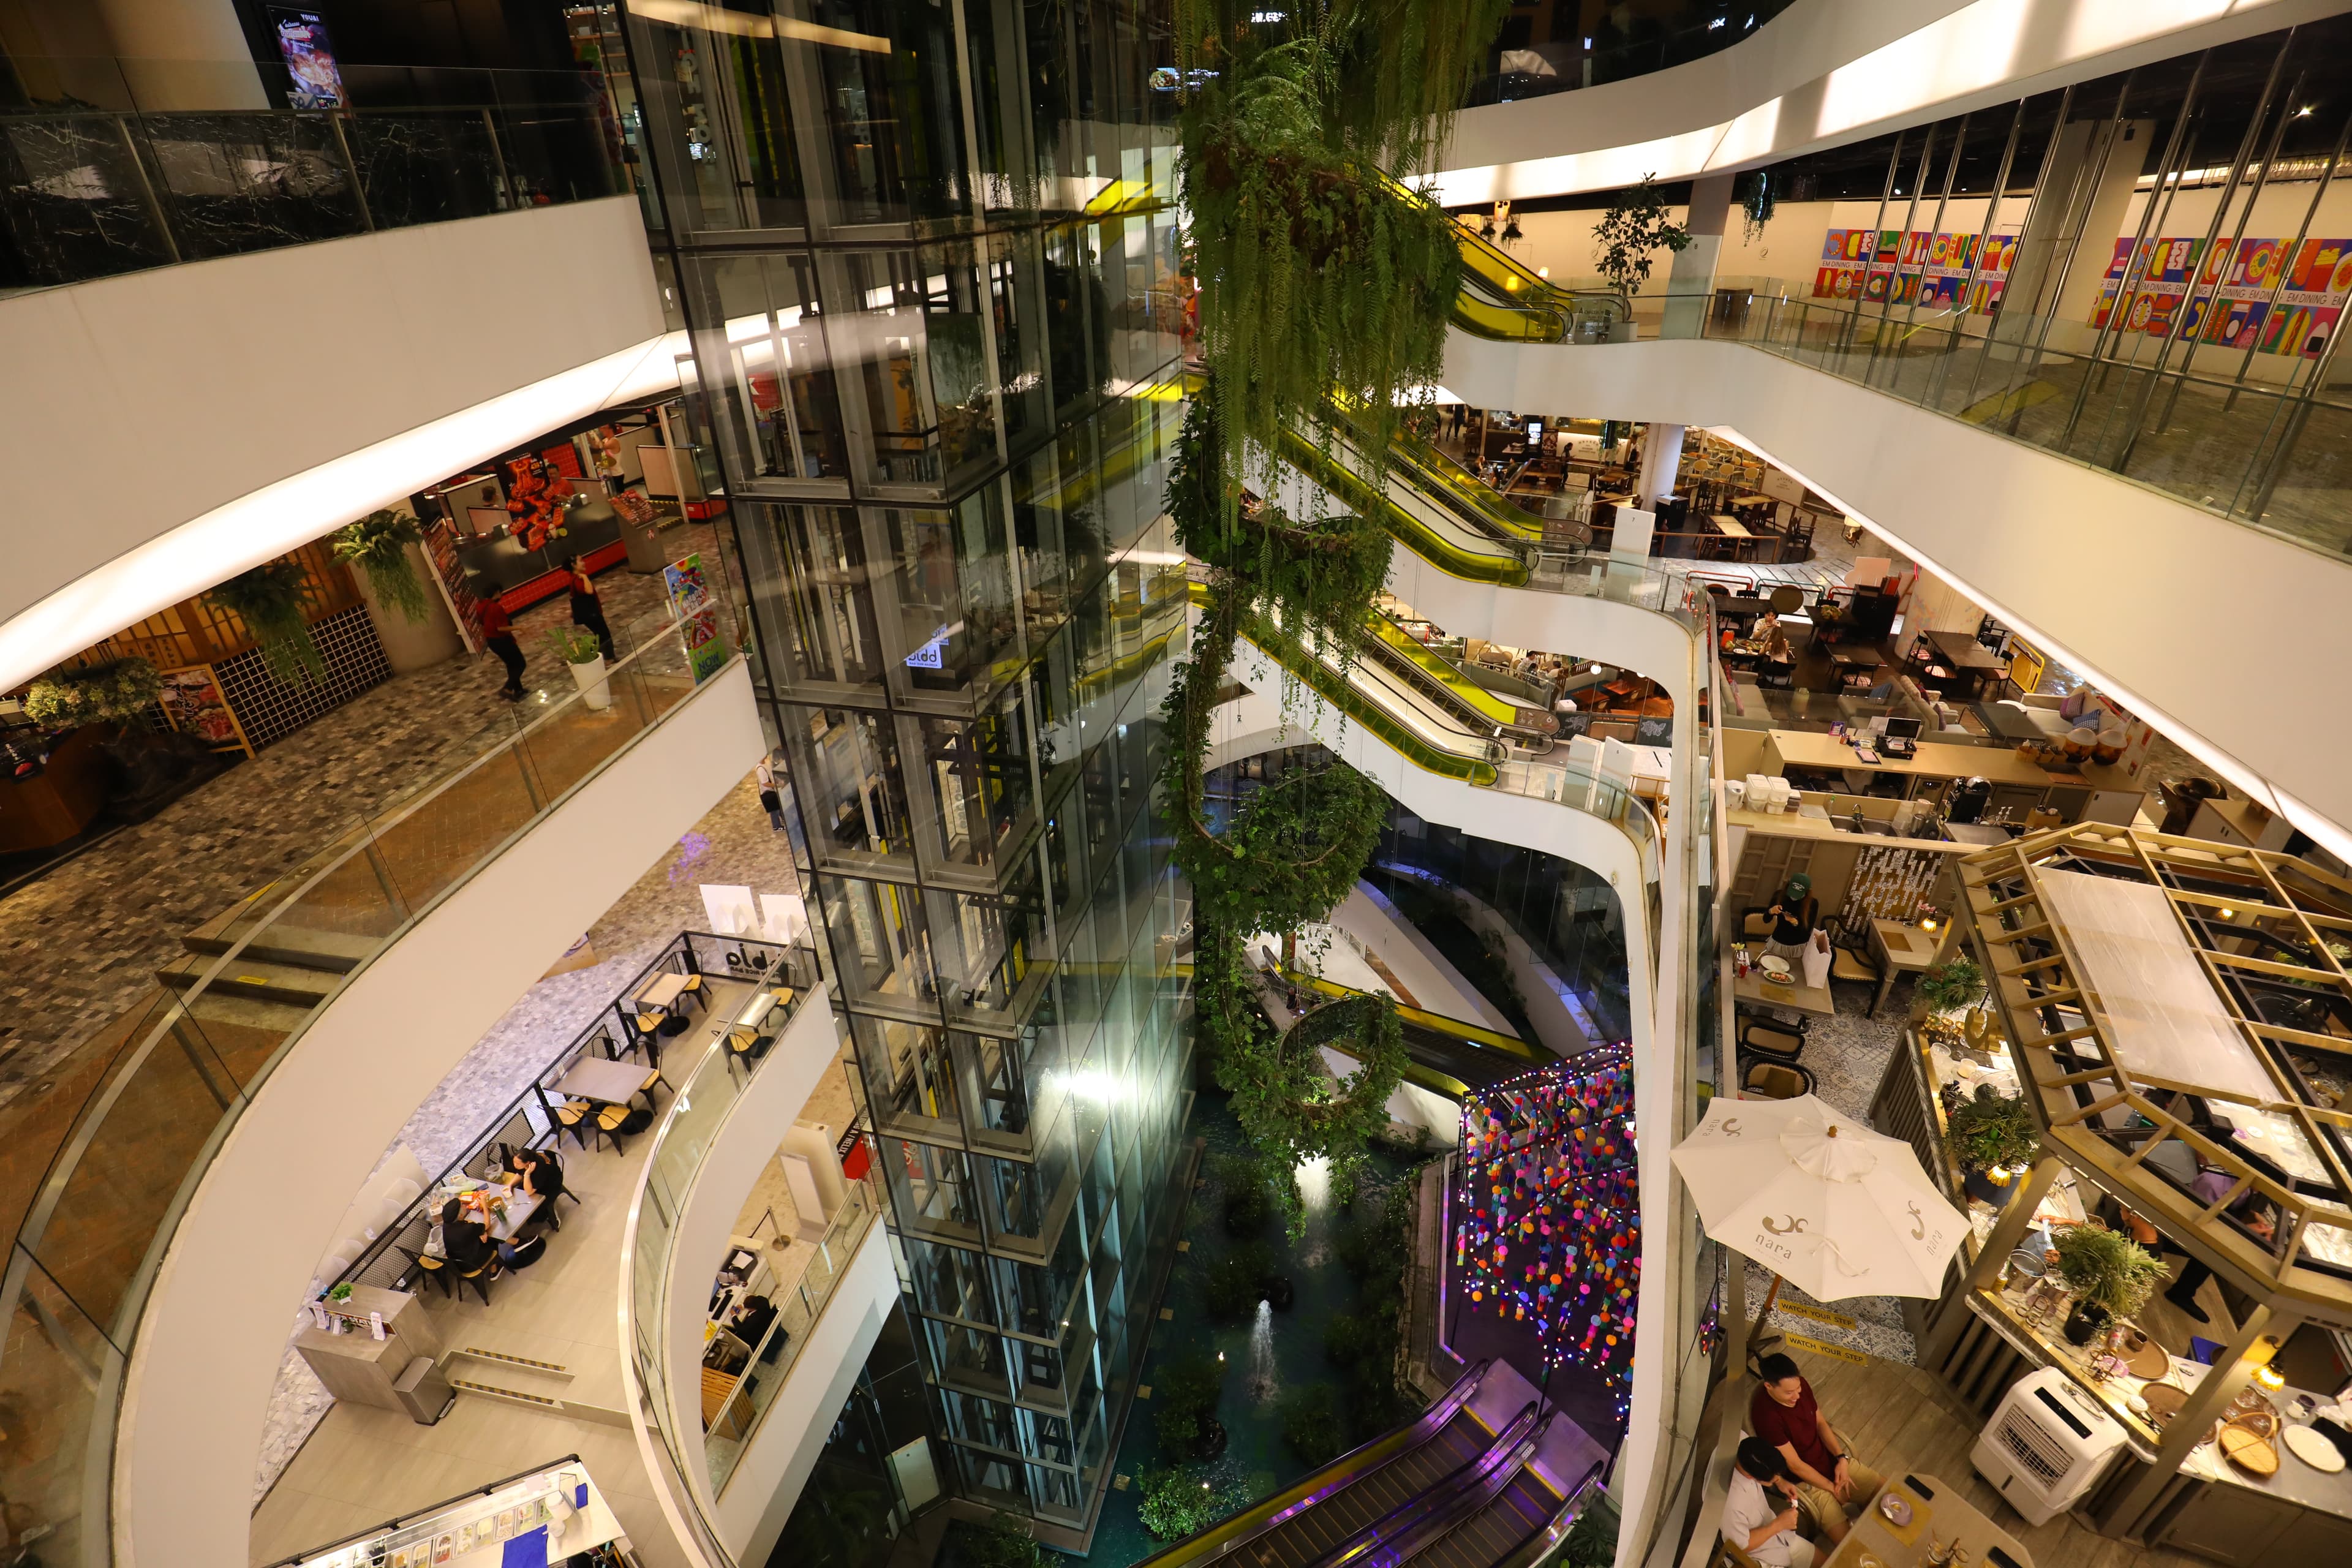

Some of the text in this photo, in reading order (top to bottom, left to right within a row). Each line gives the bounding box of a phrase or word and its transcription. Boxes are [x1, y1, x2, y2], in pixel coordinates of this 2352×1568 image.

[2150, 284, 2171, 292] DINING
[2222, 288, 2245, 298] DINING
[2248, 290, 2259, 299] EM
[2286, 293, 2297, 302] EM
[2299, 294, 2327, 304] DINING
[1578, 526, 1584, 535] 7
[698, 651, 719, 670] NOW
[1702, 1119, 1720, 1136] nara
[839, 1137, 854, 1154] HELIX
[1755, 1234, 1792, 1259] nara
[1926, 1230, 1942, 1256] nara
[1782, 1303, 1852, 1325] WATCH YOUR STEP
[1790, 1337, 1863, 1362] WATCH YOUR STEP
